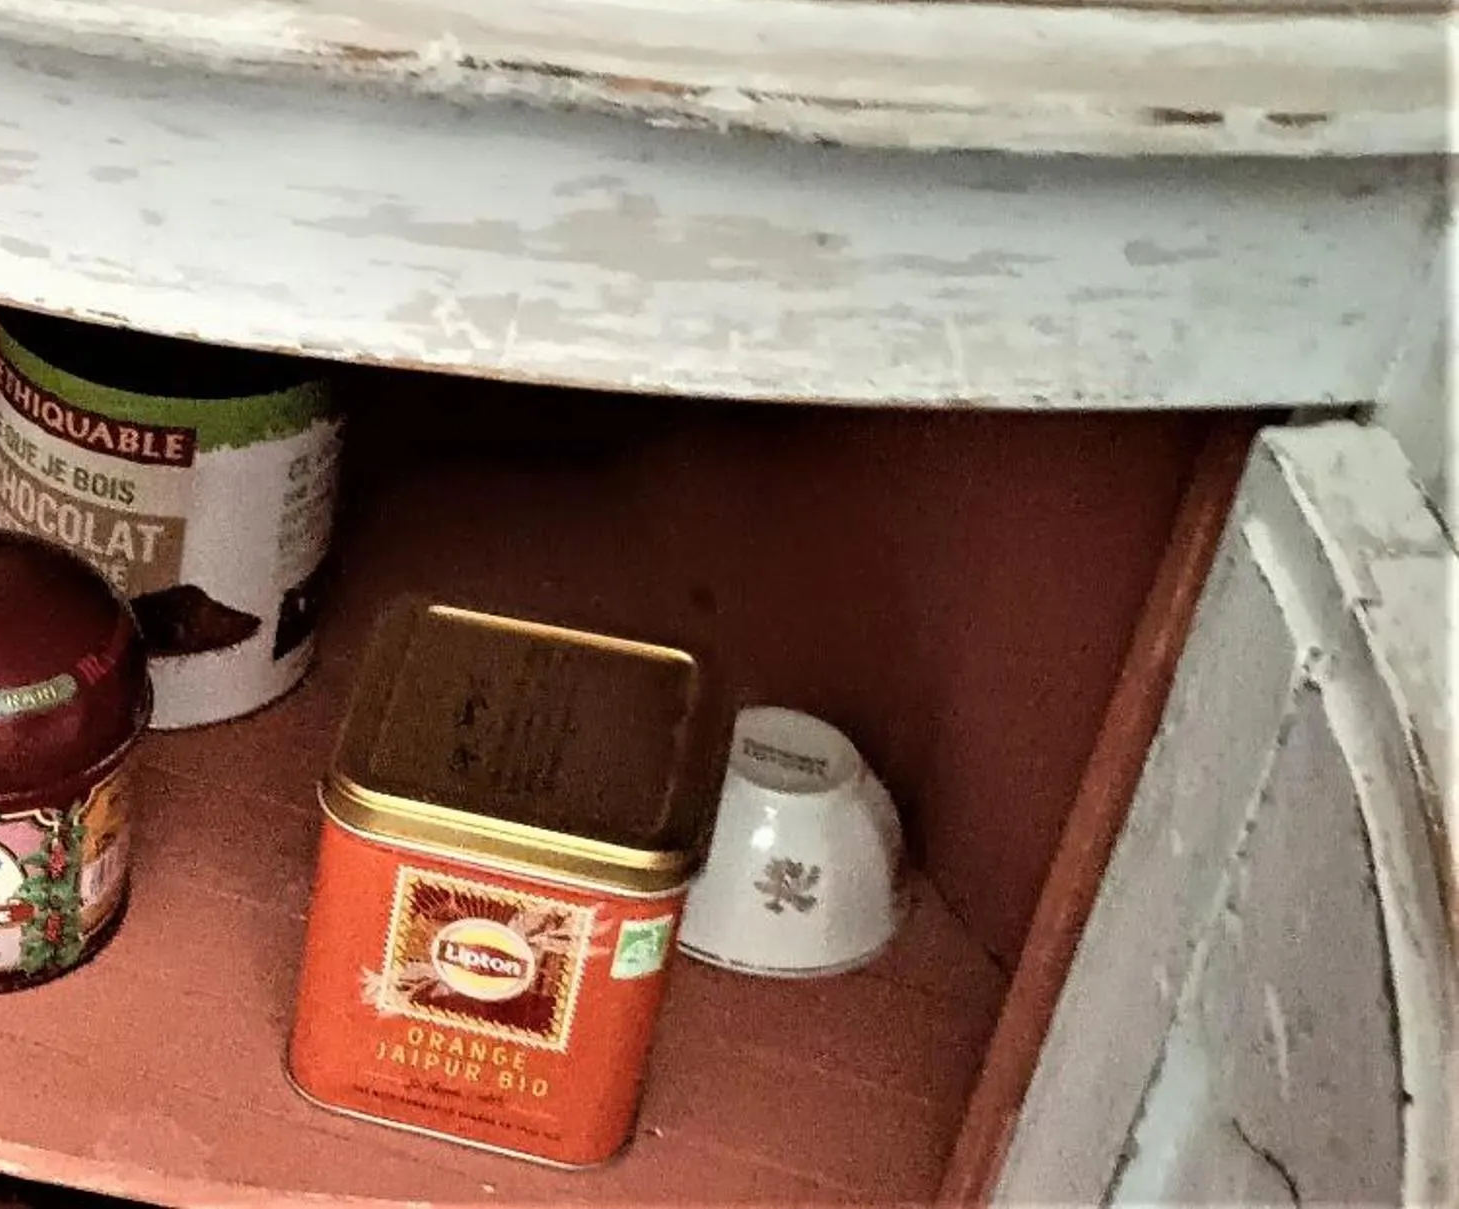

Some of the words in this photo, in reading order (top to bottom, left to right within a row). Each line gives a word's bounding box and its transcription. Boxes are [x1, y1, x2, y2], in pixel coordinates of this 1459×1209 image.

[41, 453, 67, 485] JE
[72, 466, 137, 506] BOIS
[445, 942, 523, 976] Lipton
[376, 1042, 482, 1082] JAIPUR
[498, 1070, 549, 1097] BIO
[407, 1026, 529, 1071] ORANGE
